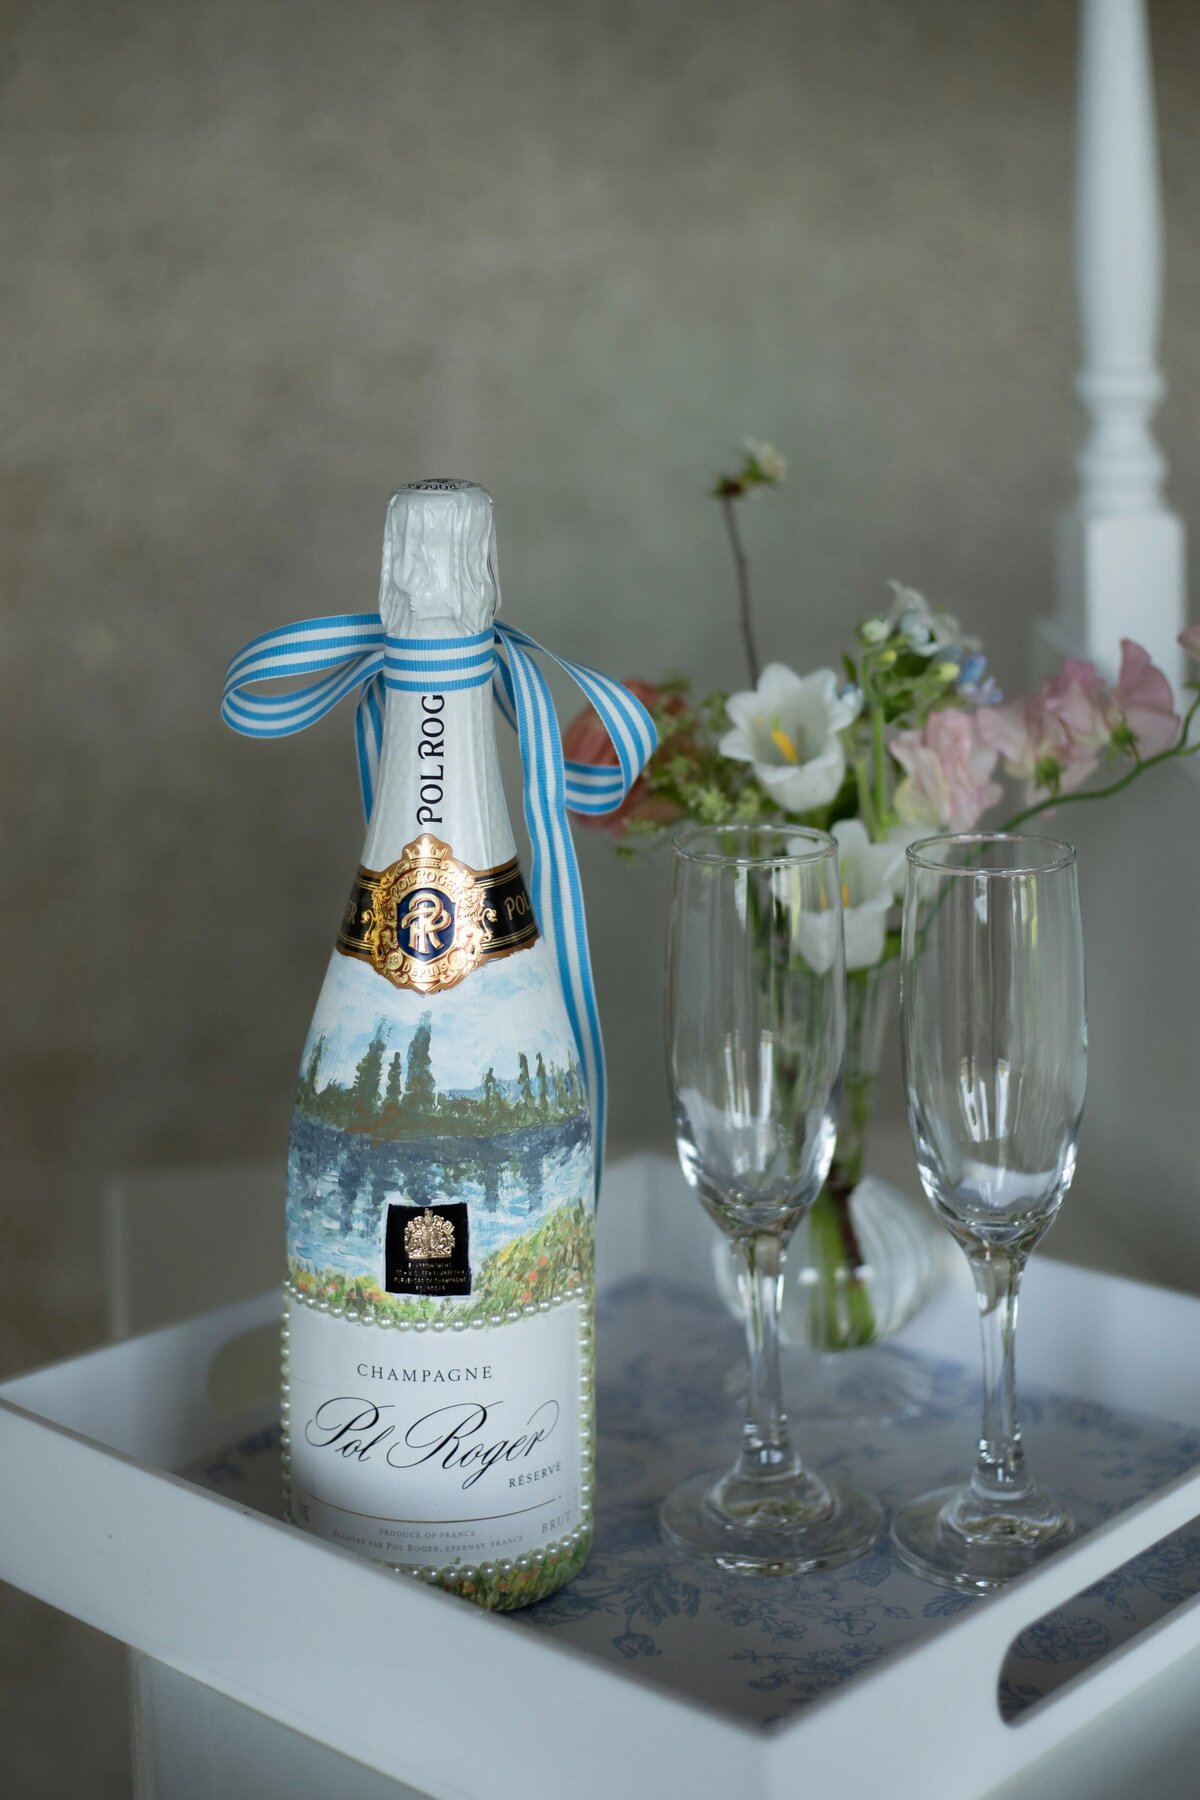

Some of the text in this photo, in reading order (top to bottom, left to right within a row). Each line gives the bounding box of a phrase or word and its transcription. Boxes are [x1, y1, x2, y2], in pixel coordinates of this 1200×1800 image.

[416, 764, 443, 825] POL
[356, 1363, 493, 1383] CHAMPAGNE
[304, 1396, 560, 1490] Pol Roger
[508, 1460, 562, 1489] RÉSERVE
[378, 1528, 476, 1540] PRODUCE OF FRANCE
[541, 1510, 572, 1535] BRUT
[490, 1535, 524, 1549] FRANCE
